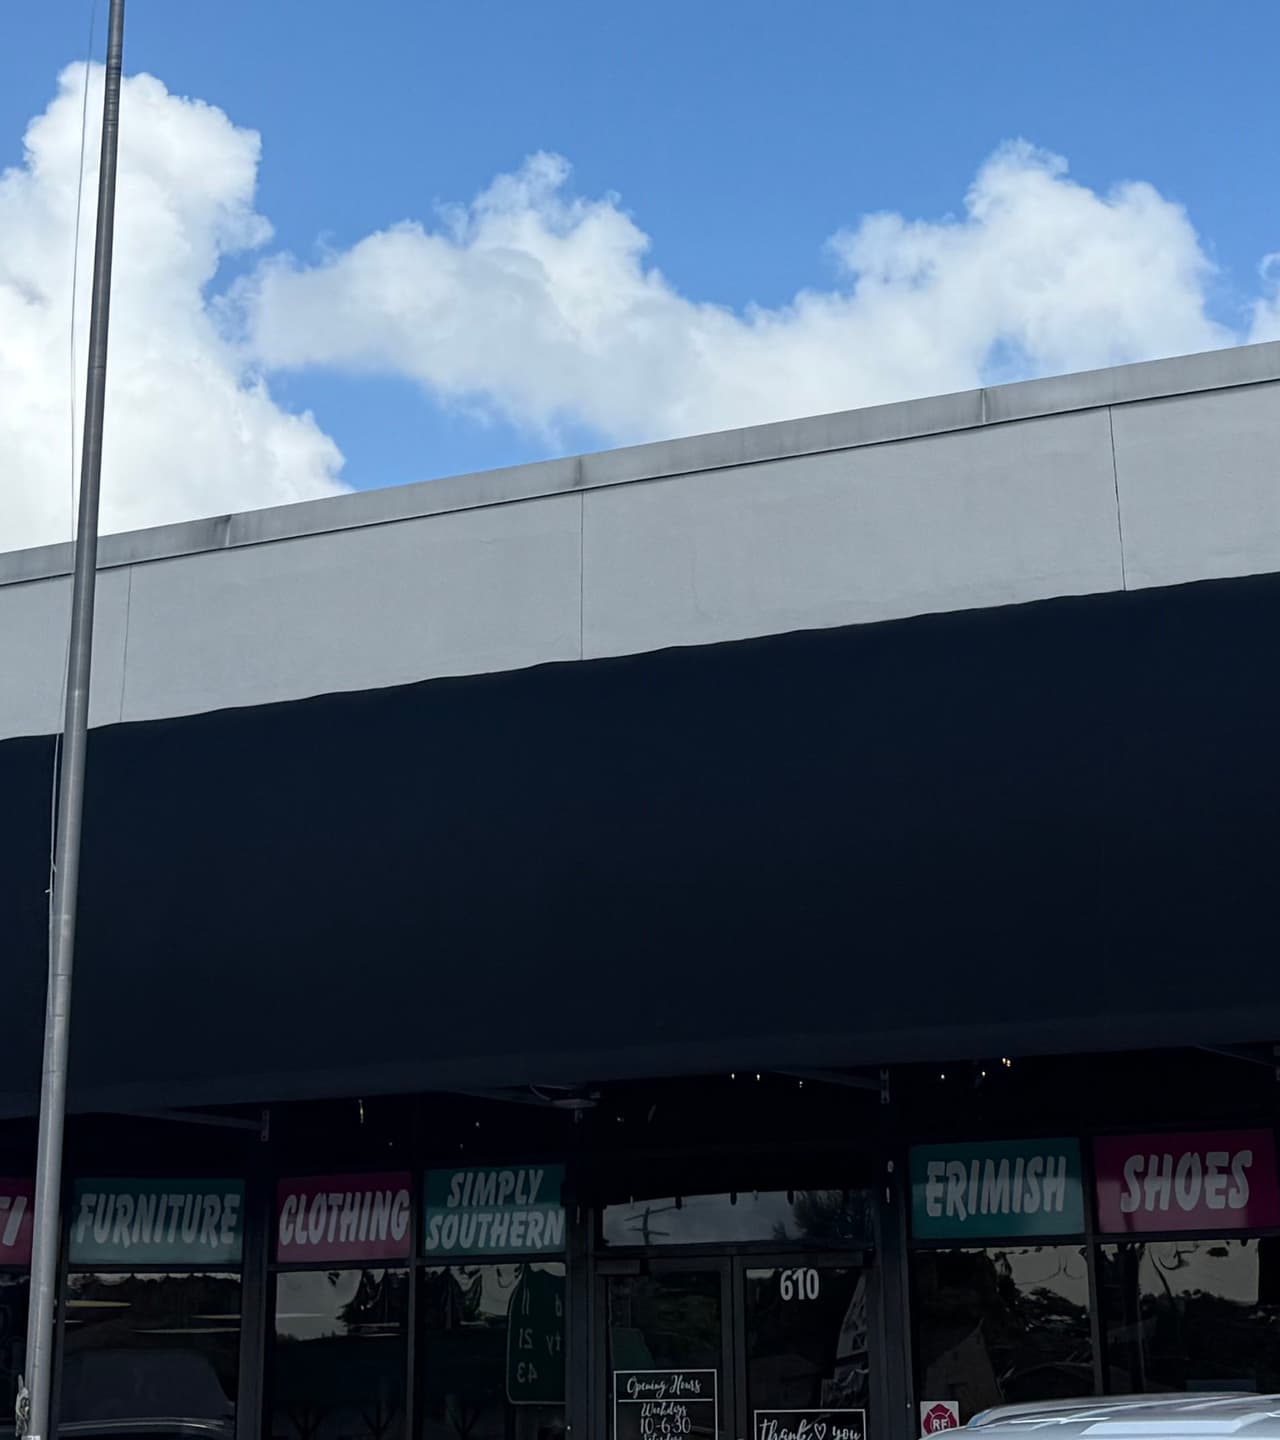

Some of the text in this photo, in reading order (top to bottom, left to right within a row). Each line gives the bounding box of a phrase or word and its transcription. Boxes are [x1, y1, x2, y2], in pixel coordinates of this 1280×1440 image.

[446, 1168, 544, 1209] SIMPLY
[925, 1155, 1067, 1222] ERIMISH
[1120, 1149, 1253, 1214] SHOES
[74, 1192, 242, 1249] FURNITURE
[278, 1188, 411, 1247] CLOTHING
[424, 1208, 566, 1251] SOUTHERN
[779, 1267, 820, 1302] 610
[627, 1375, 667, 1399] Opening
[932, 1418, 949, 1431] RF
